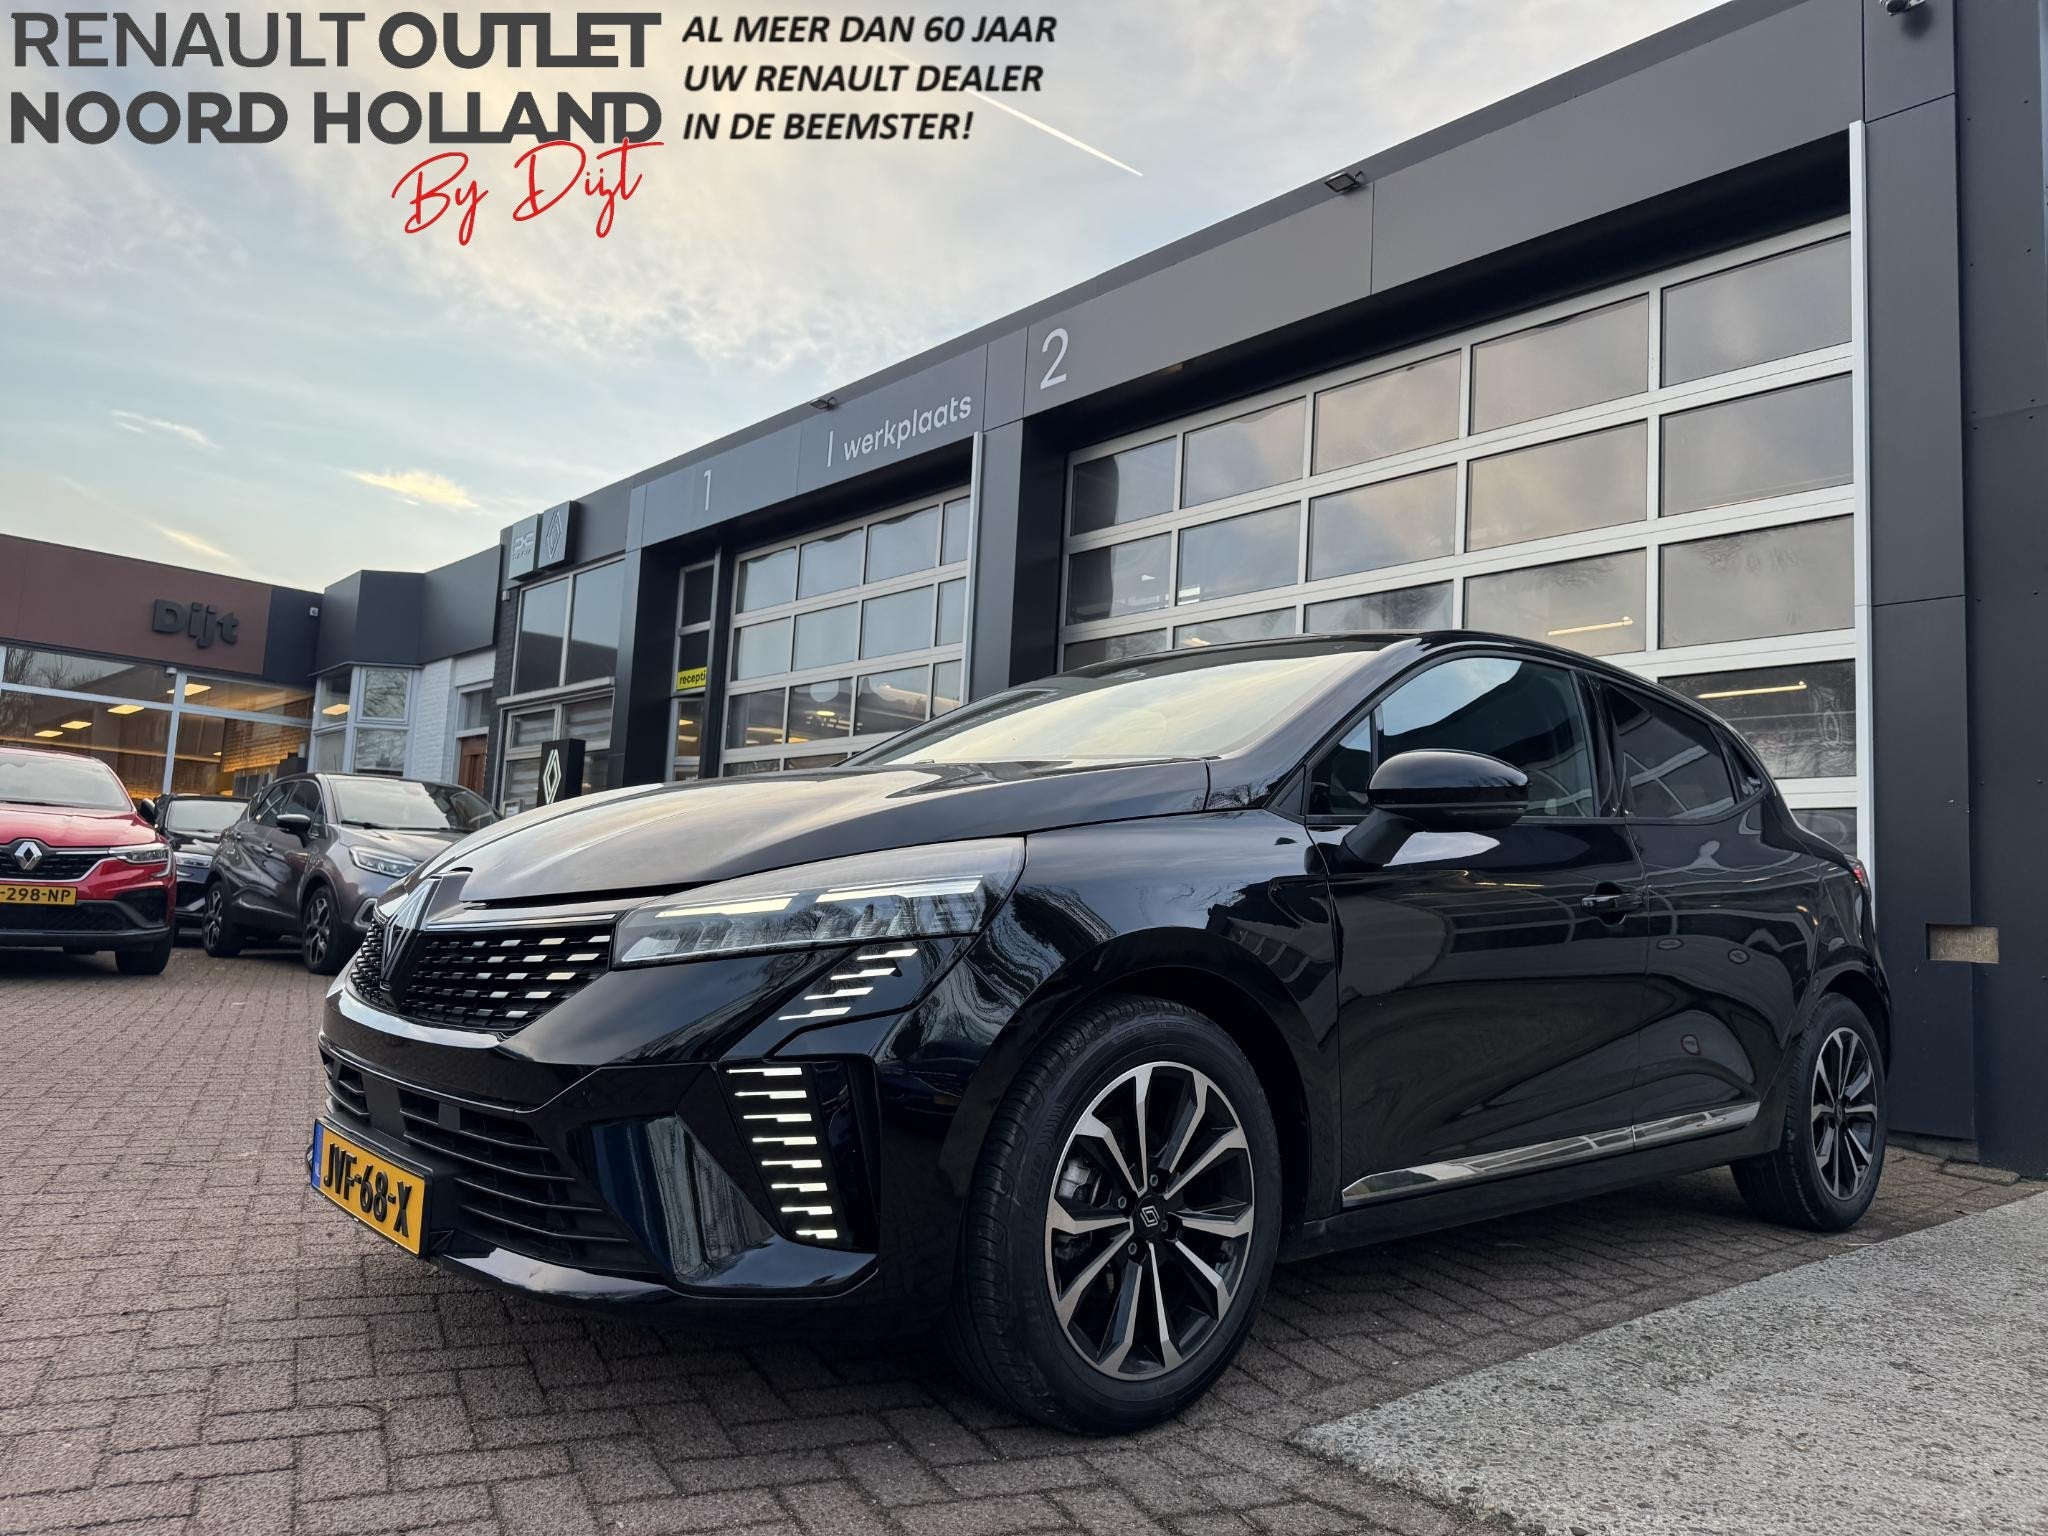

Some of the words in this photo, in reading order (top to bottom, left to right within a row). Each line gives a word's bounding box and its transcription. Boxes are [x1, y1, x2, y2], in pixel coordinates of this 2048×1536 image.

[1040, 328, 1069, 390] 2
[843, 395, 973, 461] werkplaats
[703, 469, 712, 511] 1
[152, 599, 240, 650] Dijt
[323, 1142, 412, 1238] JVF-68-X
